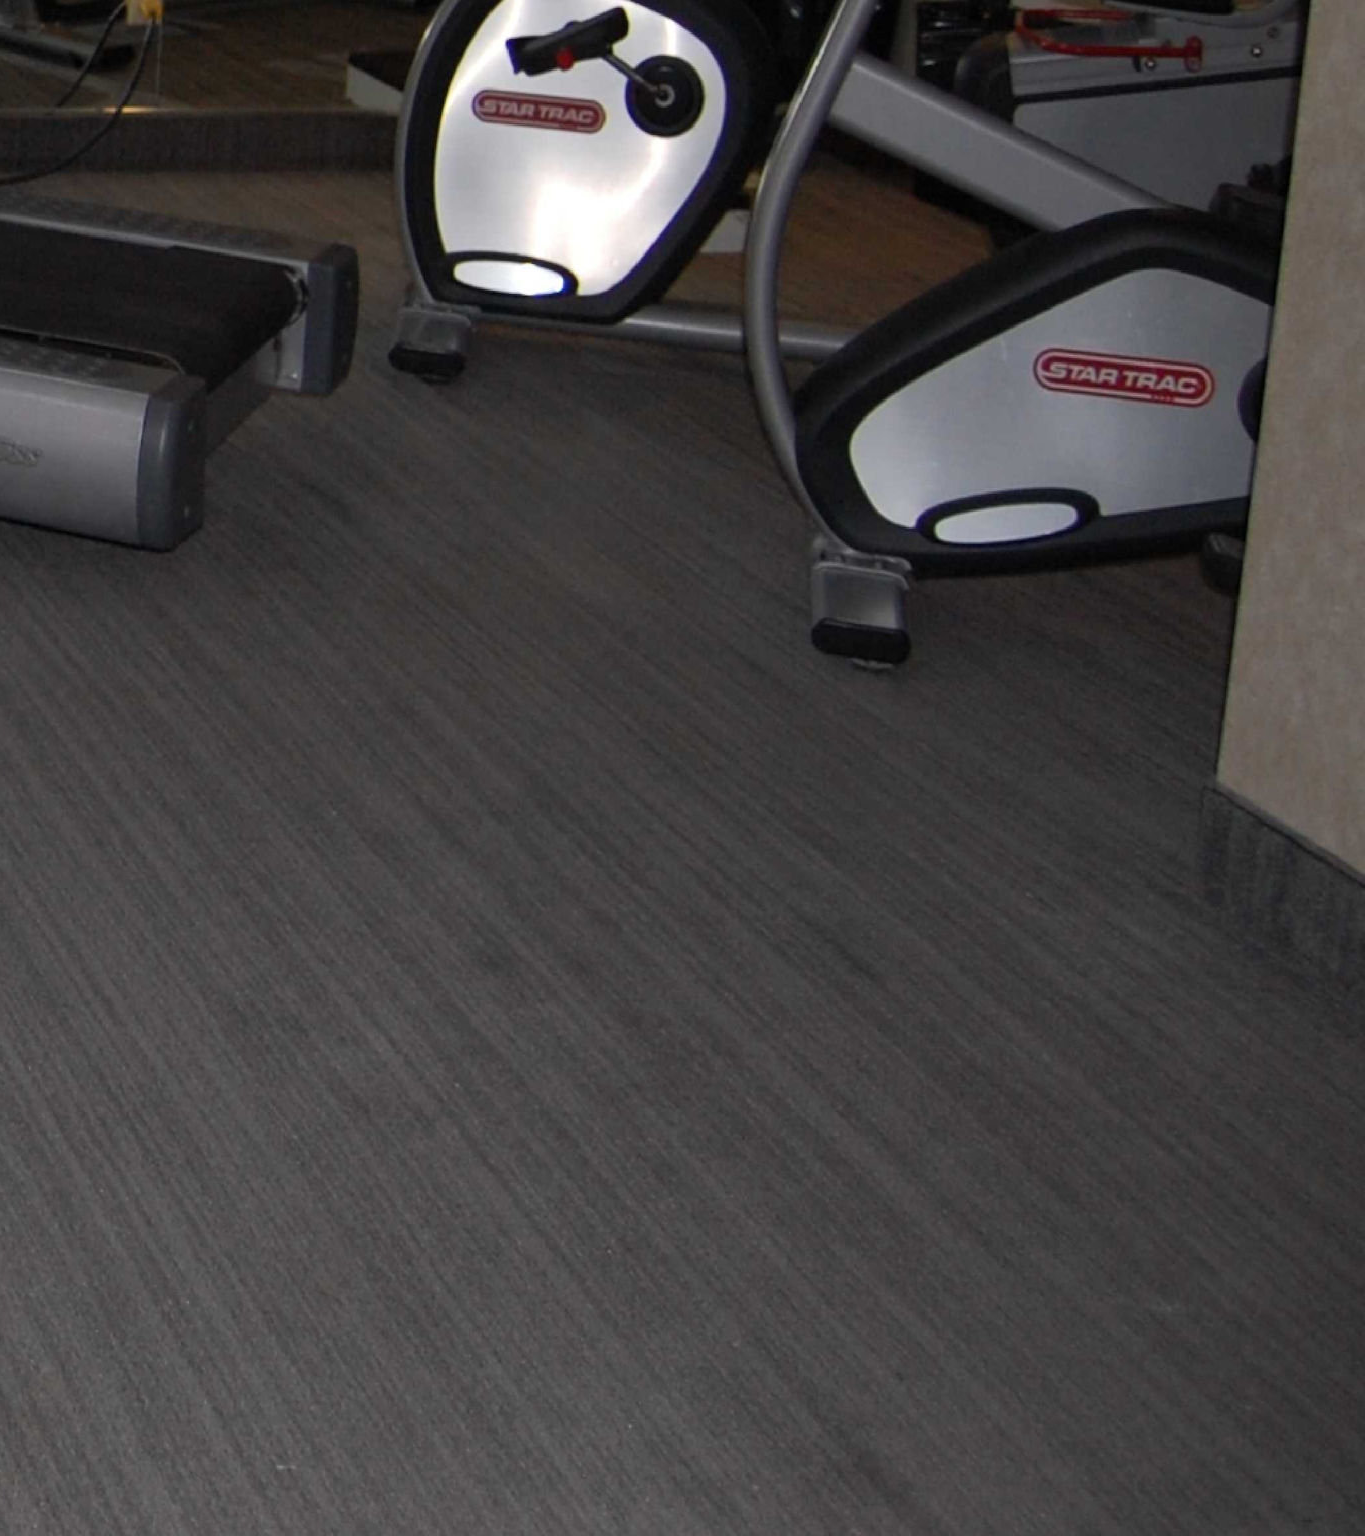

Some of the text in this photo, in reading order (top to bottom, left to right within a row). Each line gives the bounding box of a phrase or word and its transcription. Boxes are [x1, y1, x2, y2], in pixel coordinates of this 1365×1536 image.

[481, 99, 595, 124] STAR TRAC
[1048, 361, 1200, 394] STAR TRAC
